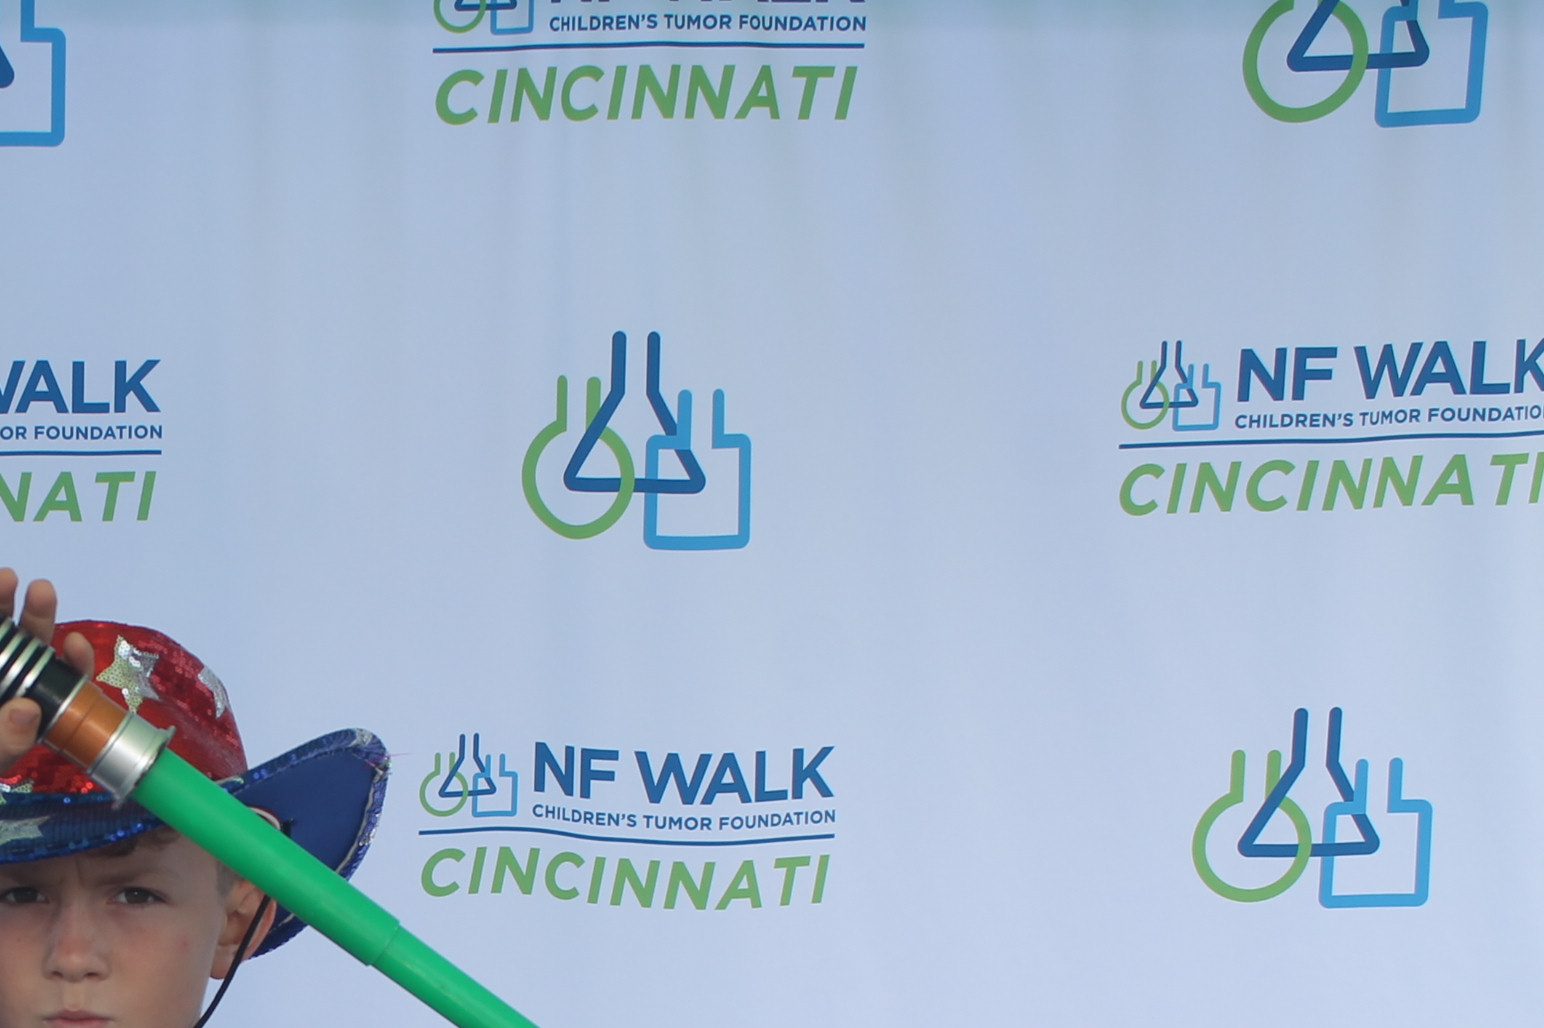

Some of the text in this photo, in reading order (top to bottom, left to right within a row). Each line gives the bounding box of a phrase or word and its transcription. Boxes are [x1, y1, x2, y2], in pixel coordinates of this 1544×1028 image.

[549, 14, 867, 32] CHILDREN'S TUMOR FOUNDATION
[436, 64, 858, 125] CINCINNATI
[1237, 338, 1544, 403] NF WALK
[34, 424, 162, 440] FOUNDATION
[1235, 404, 1544, 429] CHILDREN'S TUMOR FOUNDATIO
[1119, 452, 1544, 516] CINCINNATI
[534, 741, 835, 805] NF WALK
[533, 804, 836, 831] CHILDREN'S TUMOR FOUNDATION
[421, 846, 830, 911] CINCINNATI
